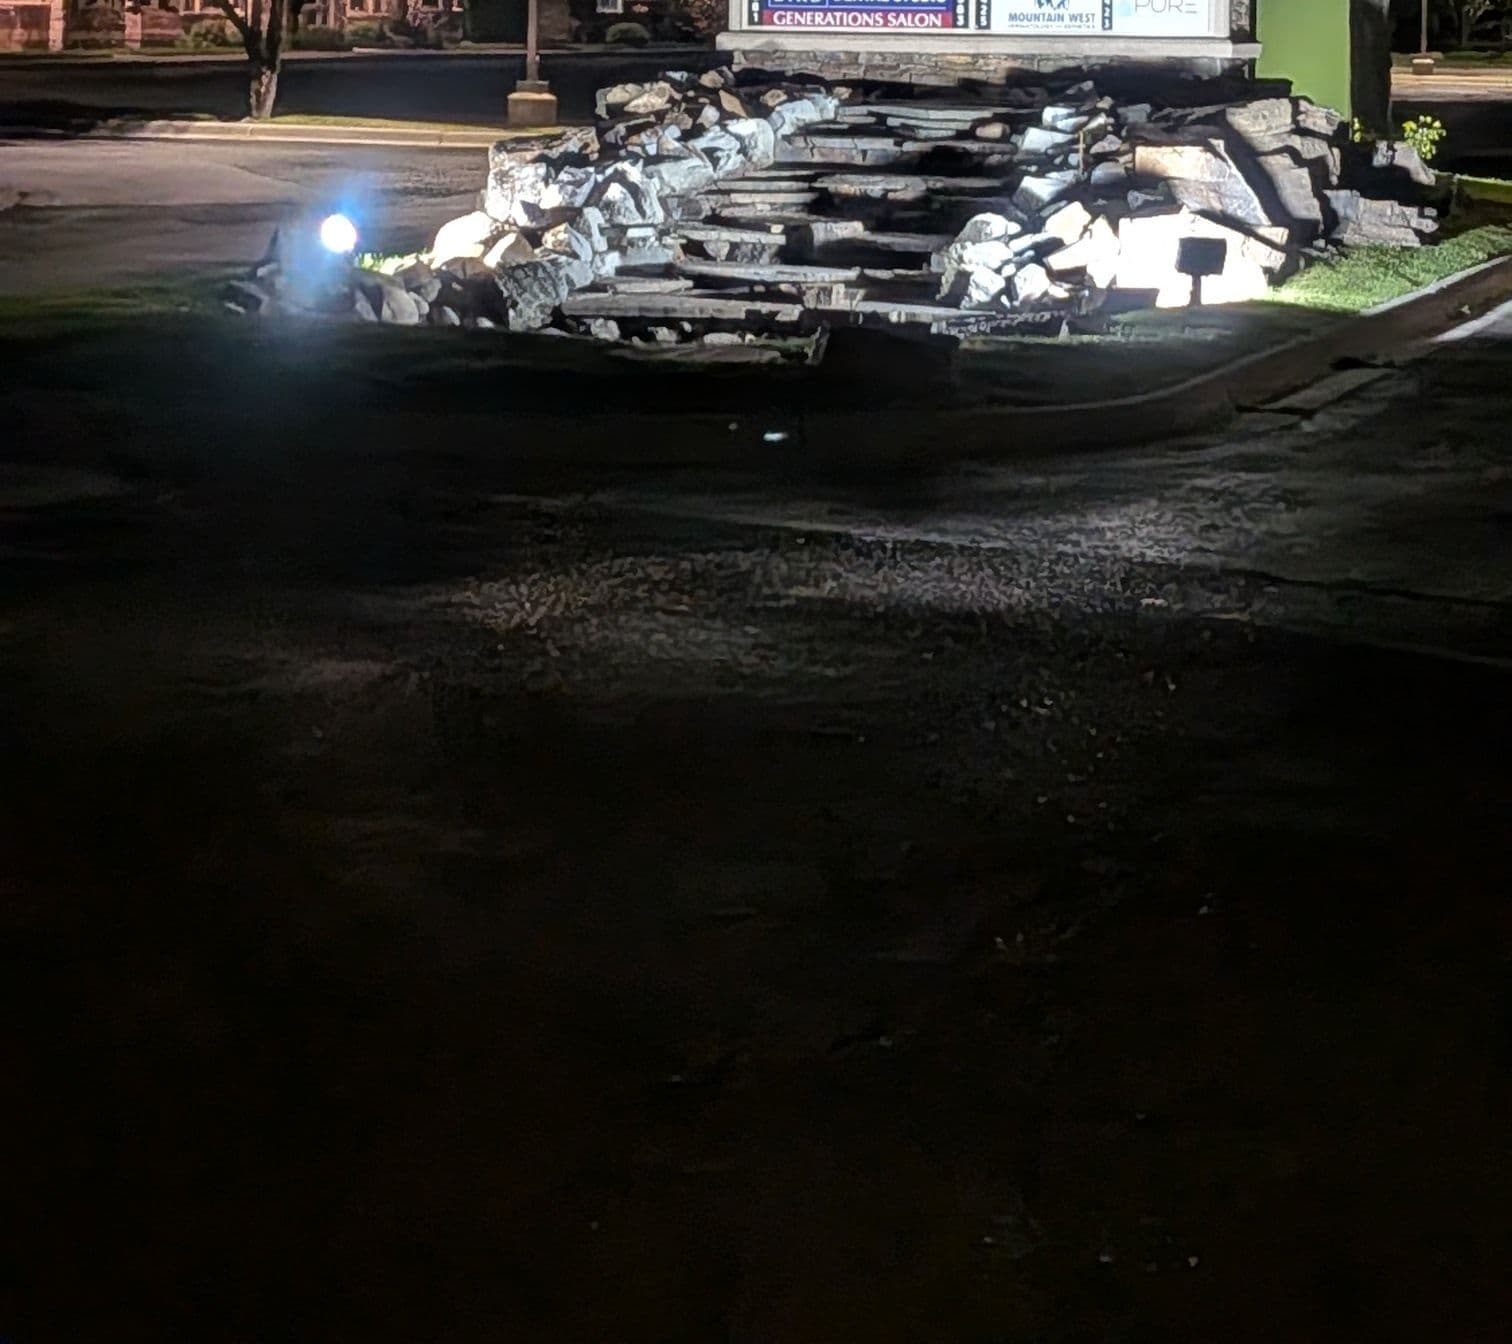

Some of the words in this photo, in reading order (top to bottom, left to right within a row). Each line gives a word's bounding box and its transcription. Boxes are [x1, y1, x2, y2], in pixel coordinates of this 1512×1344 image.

[773, 11, 883, 26] GENERATIONS
[888, 13, 942, 27] SALON
[1008, 12, 1064, 22] MOUNTAIN
[1069, 12, 1095, 23] WEST
